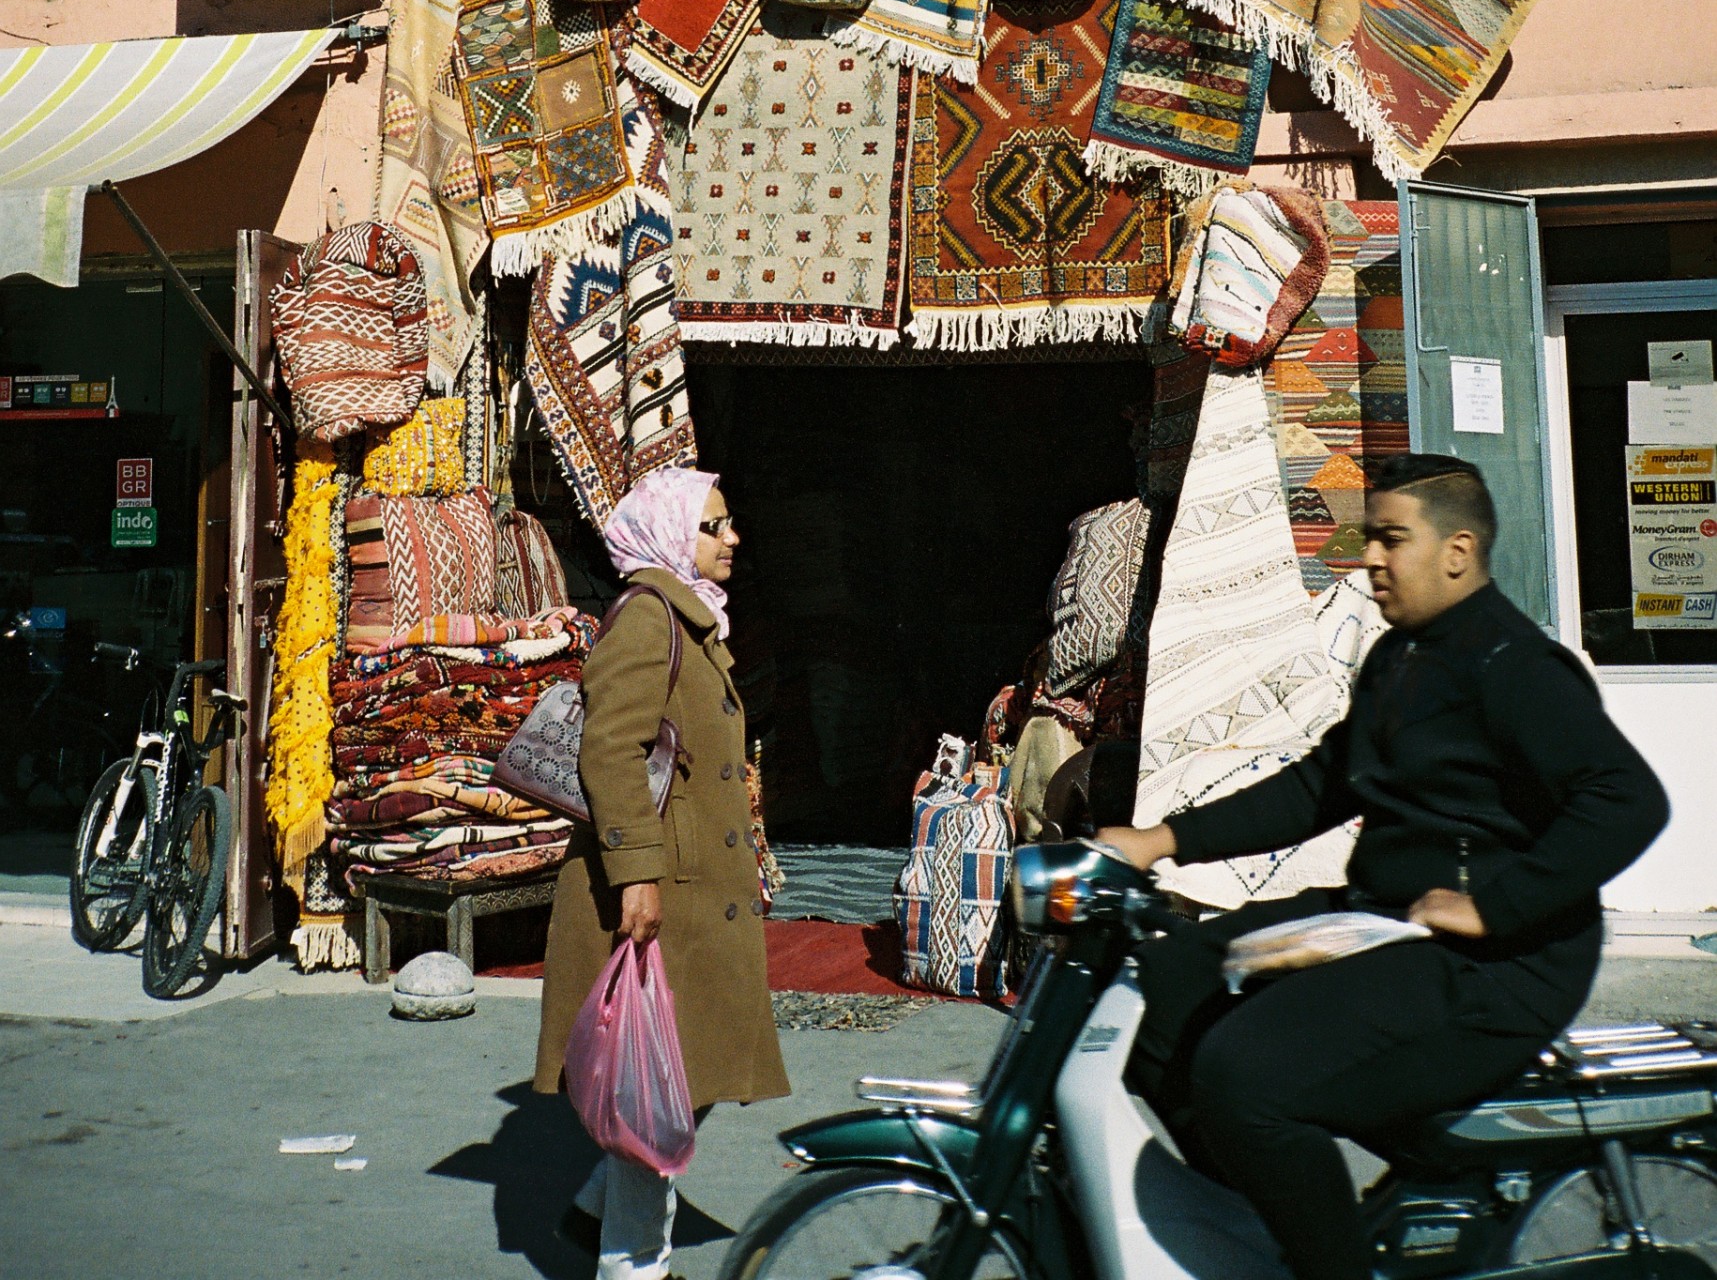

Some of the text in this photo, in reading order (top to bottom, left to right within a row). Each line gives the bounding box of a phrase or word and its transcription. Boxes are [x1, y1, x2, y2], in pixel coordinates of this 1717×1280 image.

[1651, 449, 1699, 463] mandati
[1664, 461, 1708, 474] express
[1633, 483, 1699, 493] WESTERN
[1654, 492, 1700, 502] UNION
[116, 511, 153, 529] indo
[1632, 524, 1697, 536] MoneyGram
[1658, 552, 1695, 560] DIRHAM
[1639, 599, 1713, 611] INSTANT CASH
